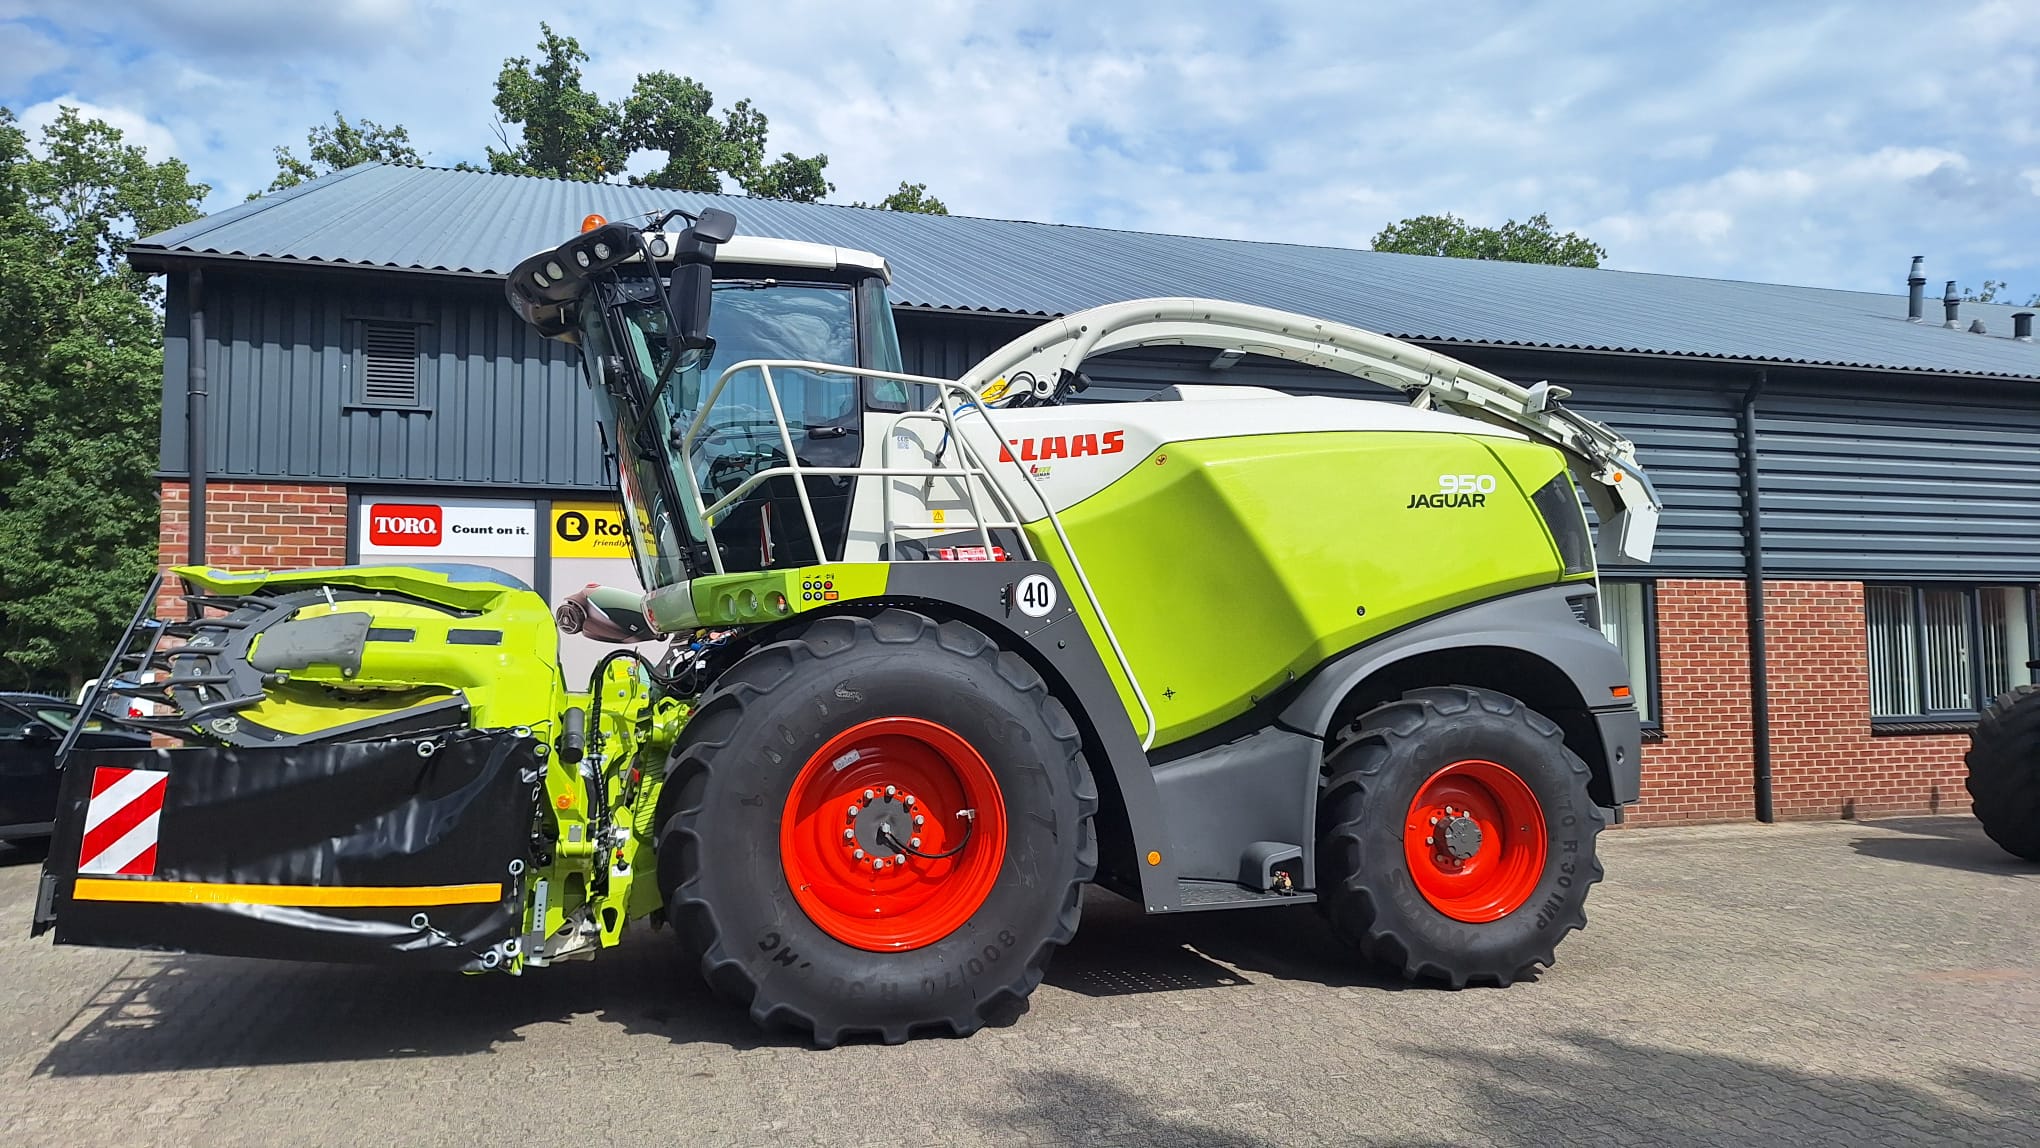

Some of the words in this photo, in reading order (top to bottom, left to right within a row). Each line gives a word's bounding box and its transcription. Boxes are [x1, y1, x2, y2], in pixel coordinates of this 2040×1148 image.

[998, 430, 1124, 463] CLAAS
[1438, 474, 1496, 494] 950
[1406, 493, 1486, 509] JAGUAR
[451, 524, 494, 535] Count
[496, 527, 514, 536] on
[515, 526, 530, 536] it.
[1023, 581, 1049, 608] 40
